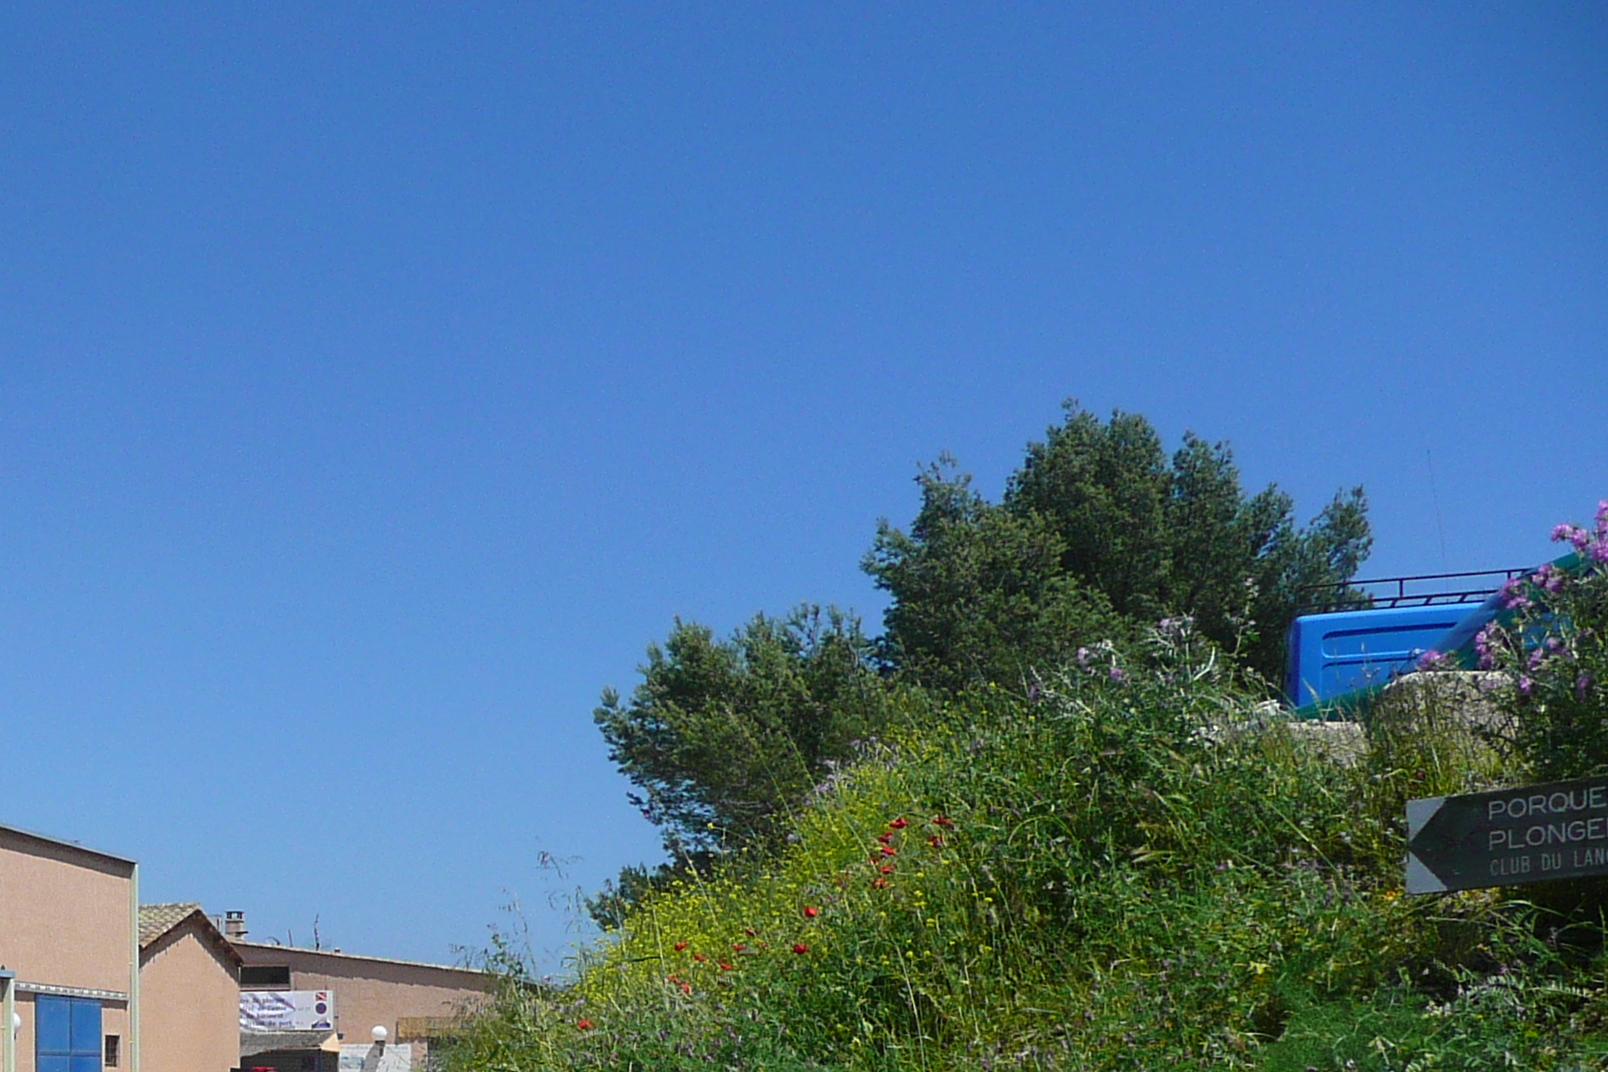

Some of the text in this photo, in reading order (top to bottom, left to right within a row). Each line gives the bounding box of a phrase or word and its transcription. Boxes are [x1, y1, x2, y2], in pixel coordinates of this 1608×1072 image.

[1488, 786, 1608, 820] PORQUE
[1488, 817, 1608, 851] PLONGE
[1489, 847, 1608, 876] CLUB DU LAN
